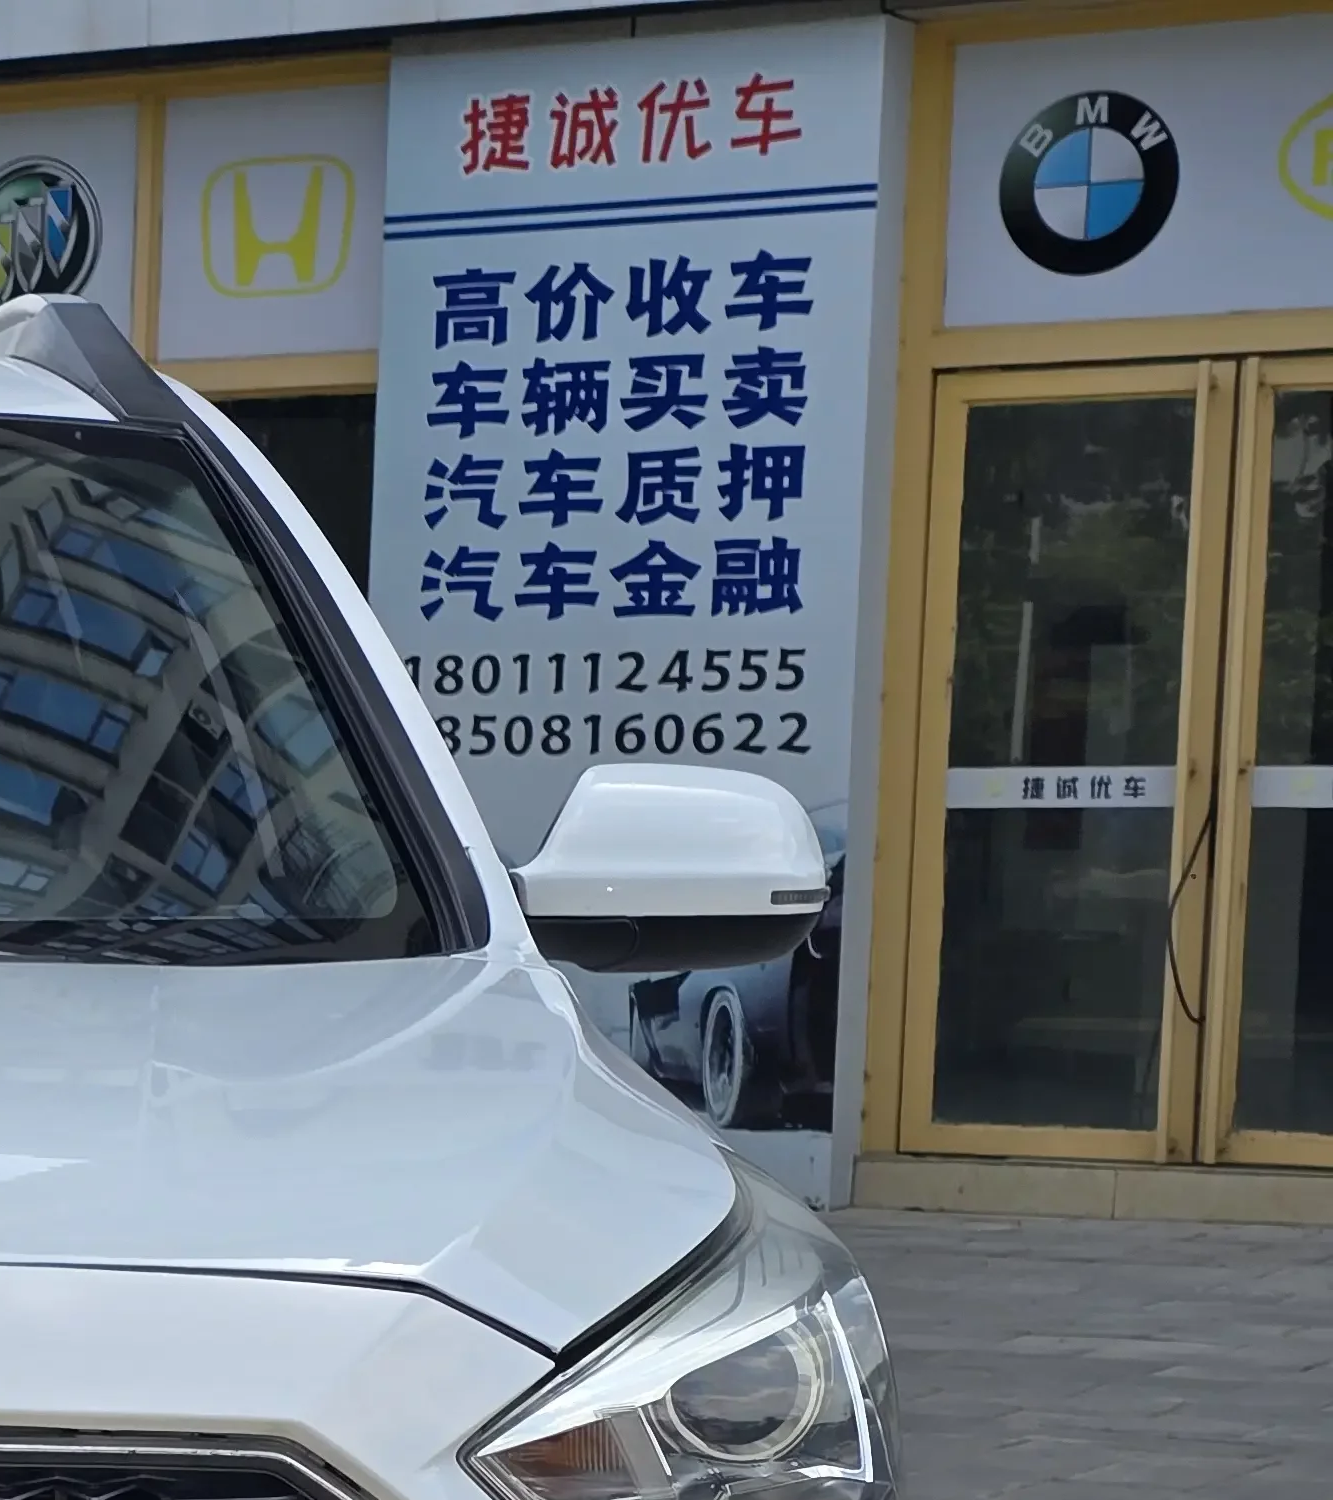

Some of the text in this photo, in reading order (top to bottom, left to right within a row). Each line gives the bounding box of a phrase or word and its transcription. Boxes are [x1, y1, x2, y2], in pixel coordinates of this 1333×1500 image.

[460, 72, 803, 175] 捷诚优车
[1018, 95, 1169, 157] BMW
[433, 249, 814, 349] 高价收车
[427, 346, 808, 438] 车辆买卖
[425, 443, 806, 530] 汽车质押
[420, 537, 804, 621] 汽车金融
[403, 648, 806, 695] 18011124555
[1023, 776, 1146, 799] 捷诚优车
